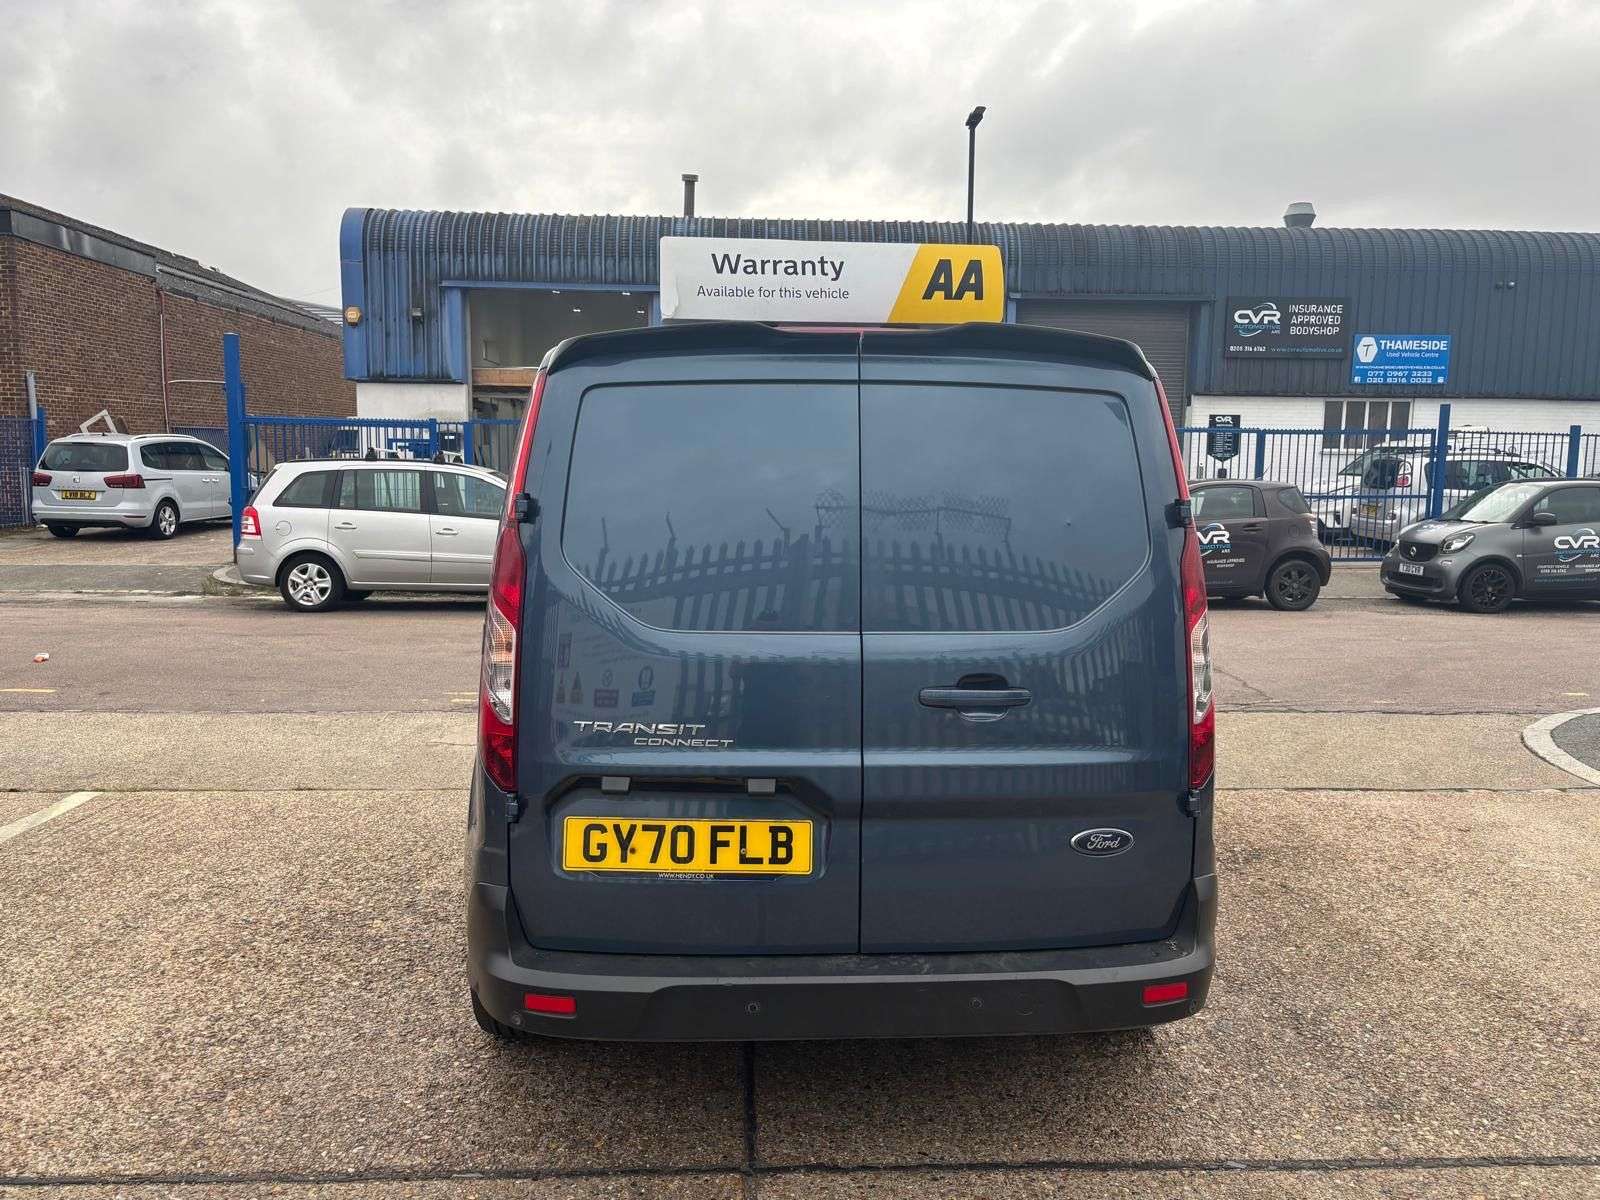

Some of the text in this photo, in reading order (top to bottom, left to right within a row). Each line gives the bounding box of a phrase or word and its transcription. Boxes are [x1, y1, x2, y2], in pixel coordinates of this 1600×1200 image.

[711, 252, 845, 281] Warranty
[922, 258, 984, 301] AA
[697, 284, 849, 300] Available for this vehicle
[1288, 304, 1344, 314] INSURANCE
[1234, 309, 1281, 324] CVR
[1290, 315, 1341, 325] APPROVED
[1289, 326, 1340, 335] BODYSHOP
[1380, 340, 1448, 350] THAMESIDE
[1196, 530, 1230, 544] VR
[1553, 535, 1600, 548] CVR
[573, 720, 706, 736] TRANSIT
[633, 737, 734, 748] CONNECT
[582, 823, 794, 865] GY70 FLB
[1086, 833, 1121, 849] Ford
